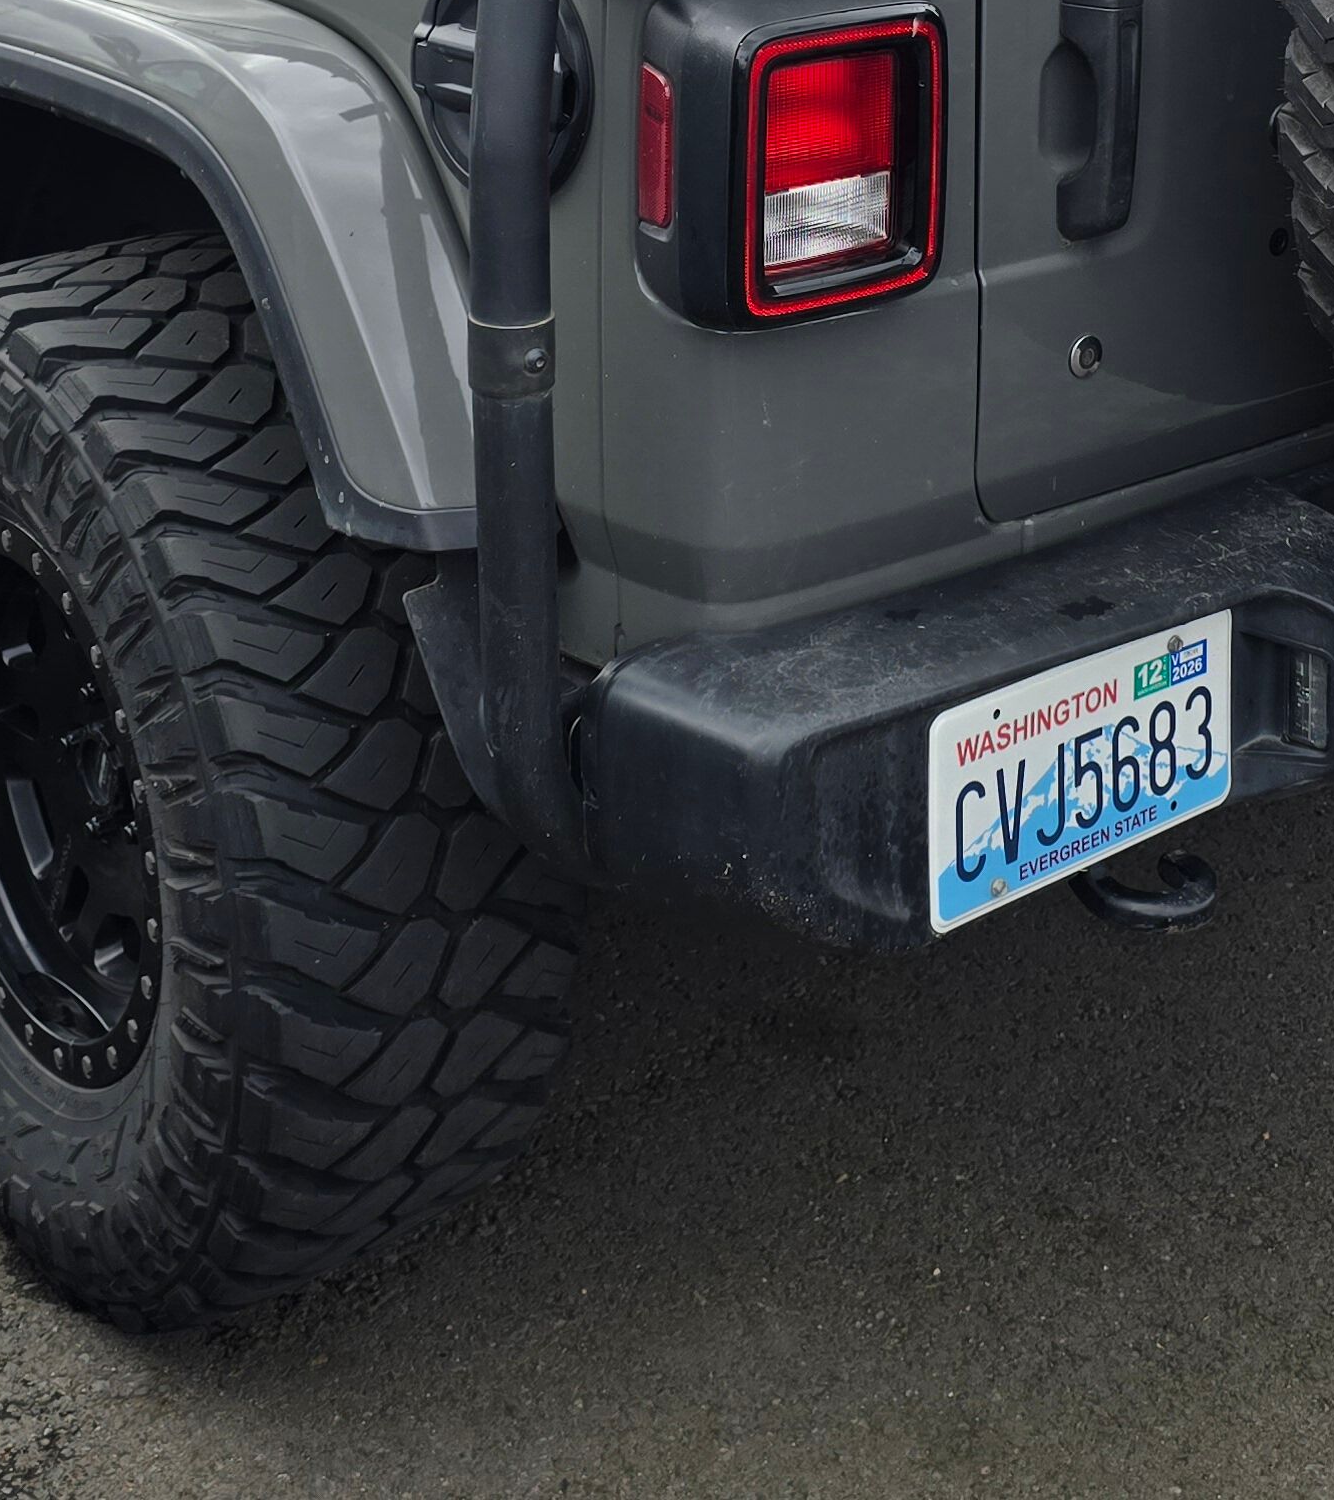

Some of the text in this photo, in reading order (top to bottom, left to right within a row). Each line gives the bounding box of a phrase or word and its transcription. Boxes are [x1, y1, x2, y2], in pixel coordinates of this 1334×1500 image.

[1137, 659, 1163, 688] 12
[1172, 657, 1203, 682] 2026
[956, 678, 1118, 768] WASHINGTON
[955, 685, 1213, 883] CVJ5683
[1019, 804, 1158, 882] EVERGREEN STATE
